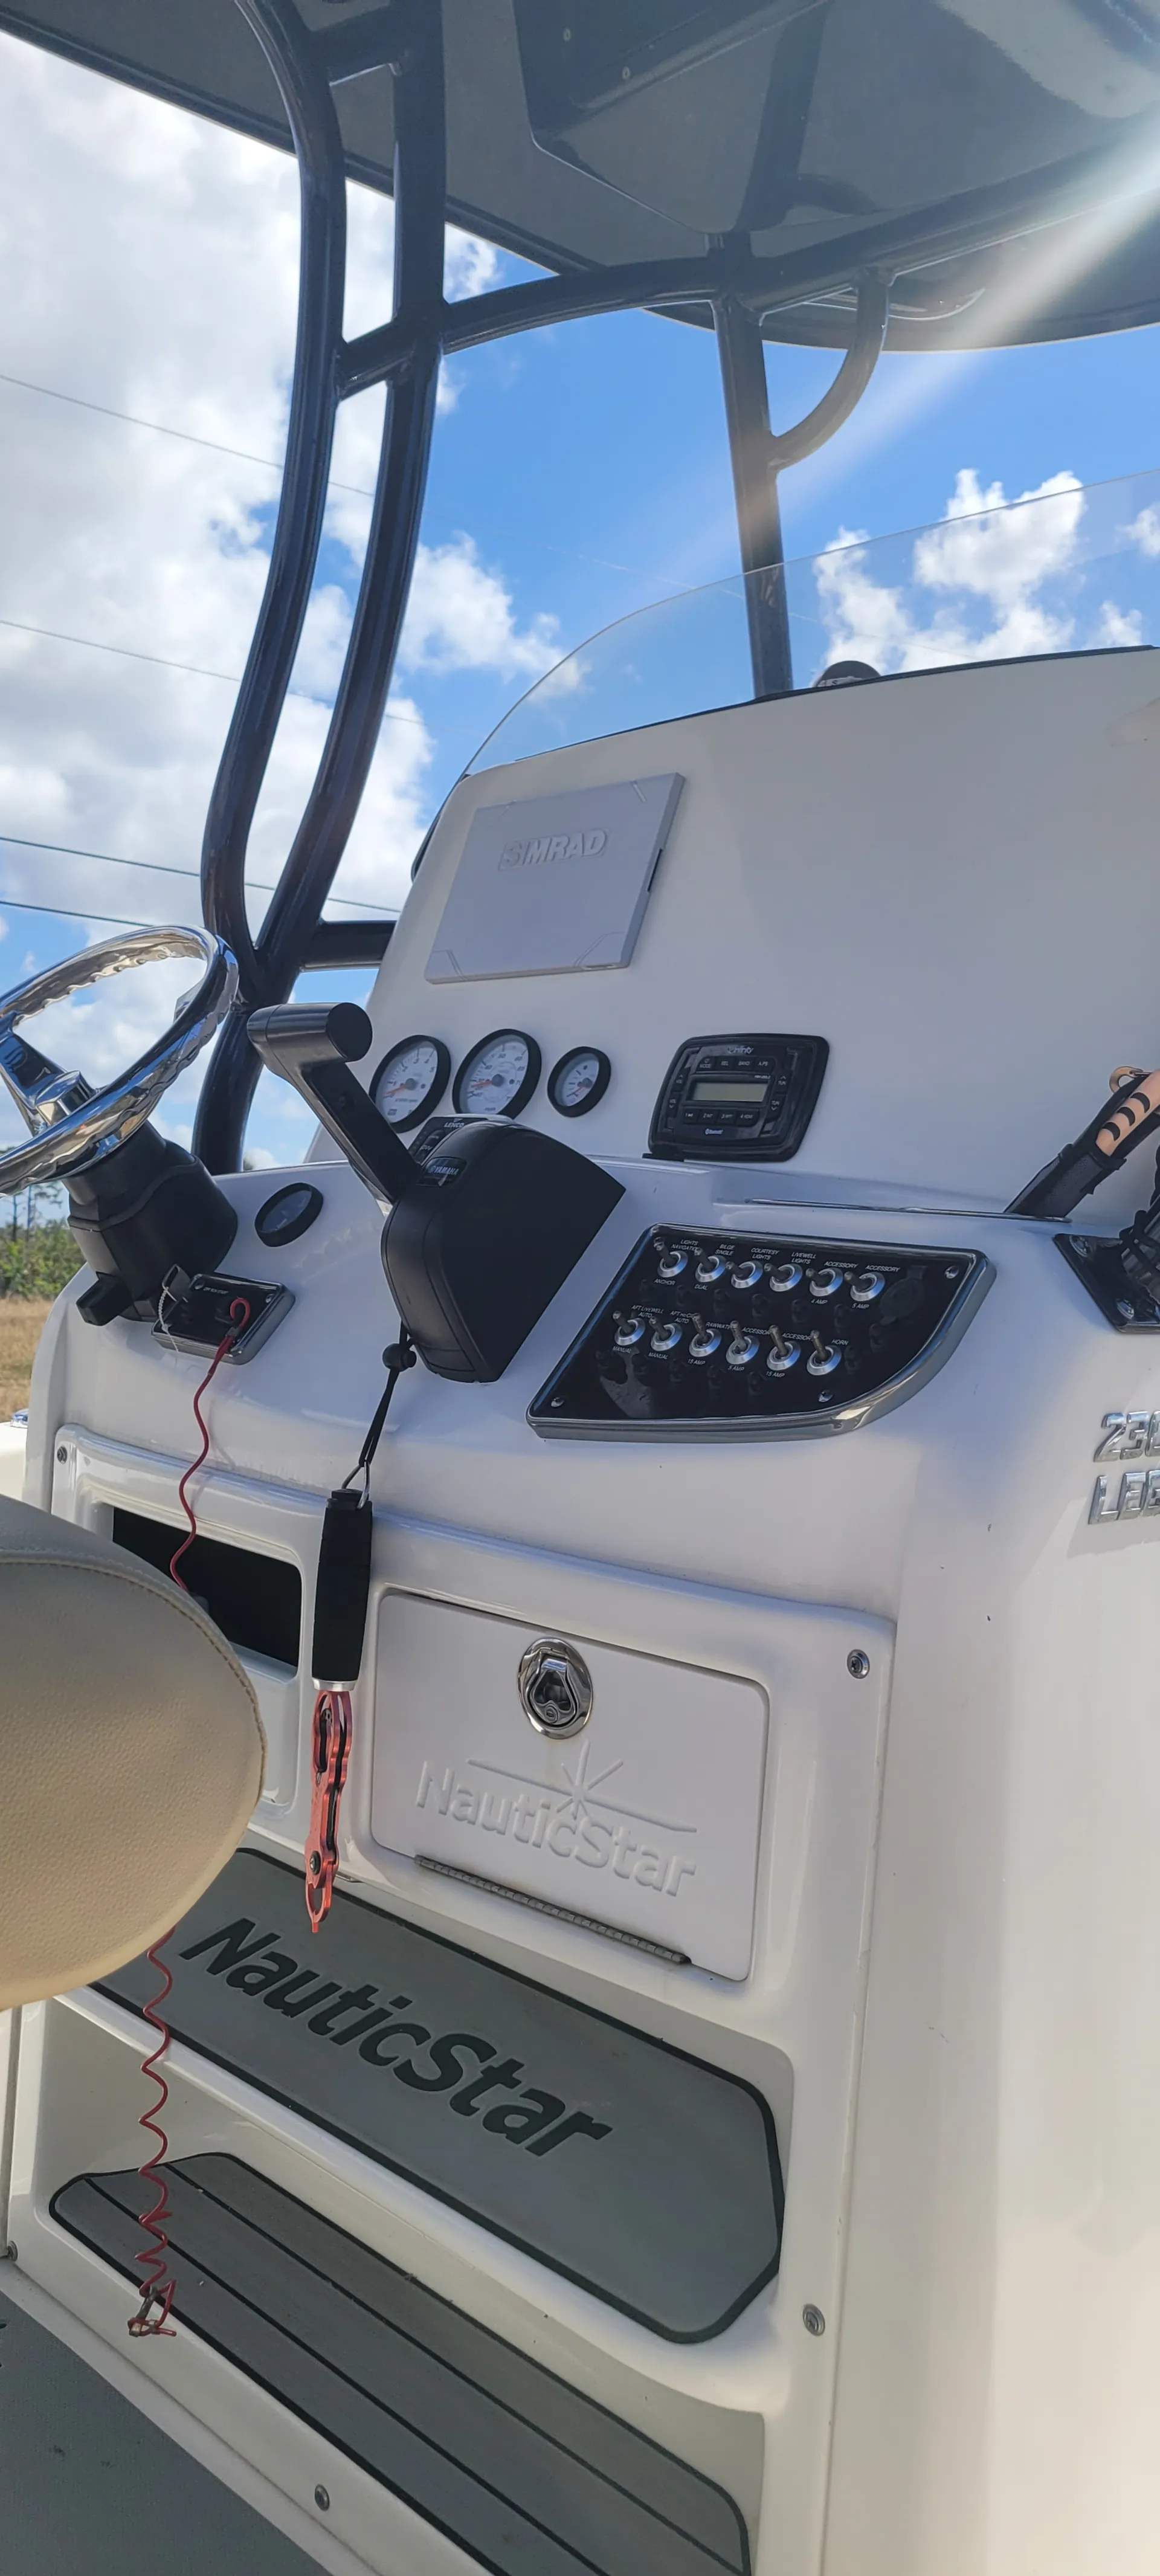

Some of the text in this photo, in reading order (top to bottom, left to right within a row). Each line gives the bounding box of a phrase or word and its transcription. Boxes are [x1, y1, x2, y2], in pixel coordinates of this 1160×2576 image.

[501, 828, 608, 869] SIMRAD
[434, 1166, 459, 1175] YAMAHA
[751, 1247, 780, 1256] COURTESY
[742, 1326, 770, 1335] ACCESSOR
[782, 1332, 811, 1341] ACCESSOR
[416, 1761, 697, 1897] NauticStar
[178, 1917, 613, 2157] NauticStar
